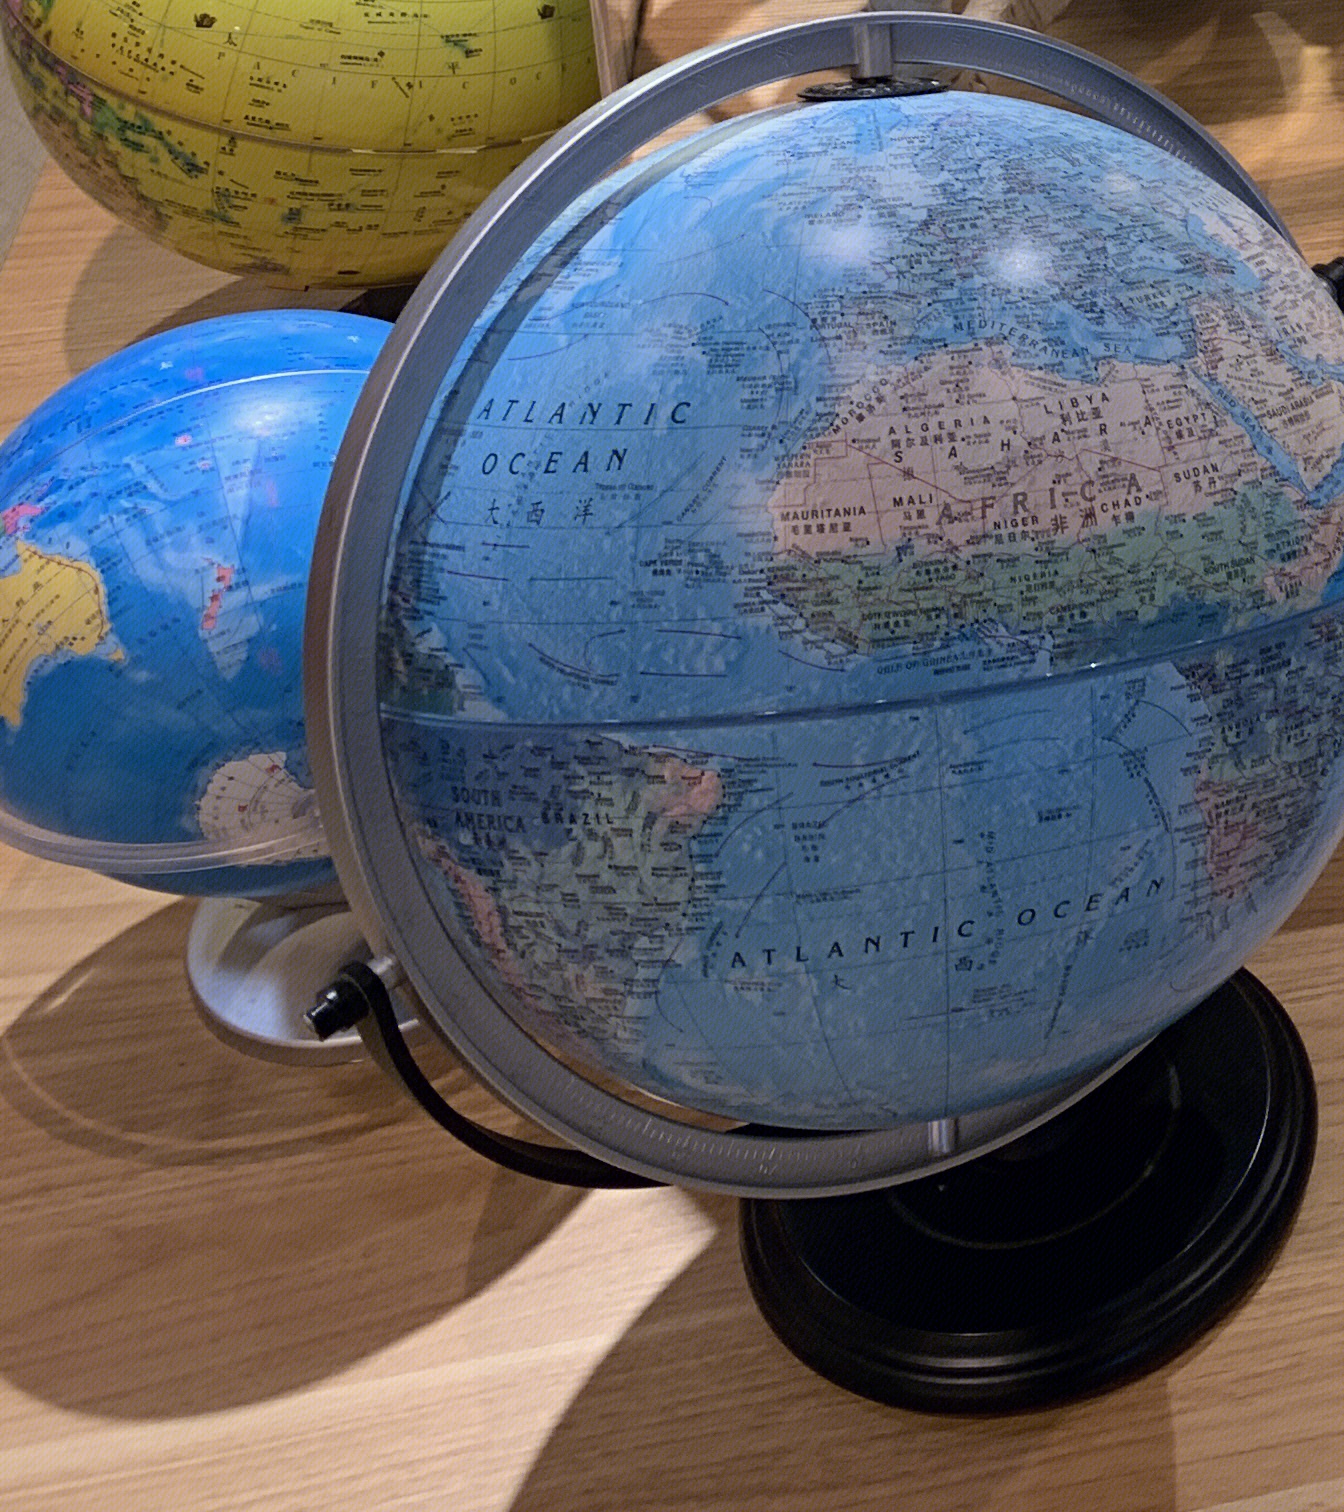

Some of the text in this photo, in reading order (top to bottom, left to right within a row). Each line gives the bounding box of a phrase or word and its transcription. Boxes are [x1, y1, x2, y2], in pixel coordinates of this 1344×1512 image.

[952, 319, 1132, 359] MEDITERRANEAN SEA
[832, 376, 888, 435] MOROCCO
[1043, 390, 1110, 415] LIBYA
[1217, 388, 1237, 409] RED
[477, 397, 692, 426] ATLANTIC
[1167, 411, 1208, 430] EGYPT
[888, 414, 991, 435] ALGERIA
[481, 447, 628, 476] OCEAN
[1172, 462, 1220, 483] SUDAN
[484, 496, 594, 526] 大西洋
[892, 493, 934, 508] MALI
[1100, 495, 1143, 513] CHAD
[780, 505, 866, 522] MAURITANIA
[992, 515, 1040, 530] NIGER
[1051, 505, 1098, 535] 非洲
[1009, 569, 1060, 584] NIGERIA
[451, 787, 501, 804] SOUTH
[454, 812, 526, 834] AMERICA
[540, 812, 616, 826] BRAZIL
[731, 876, 1166, 969] ATLANTIC OCEAN
